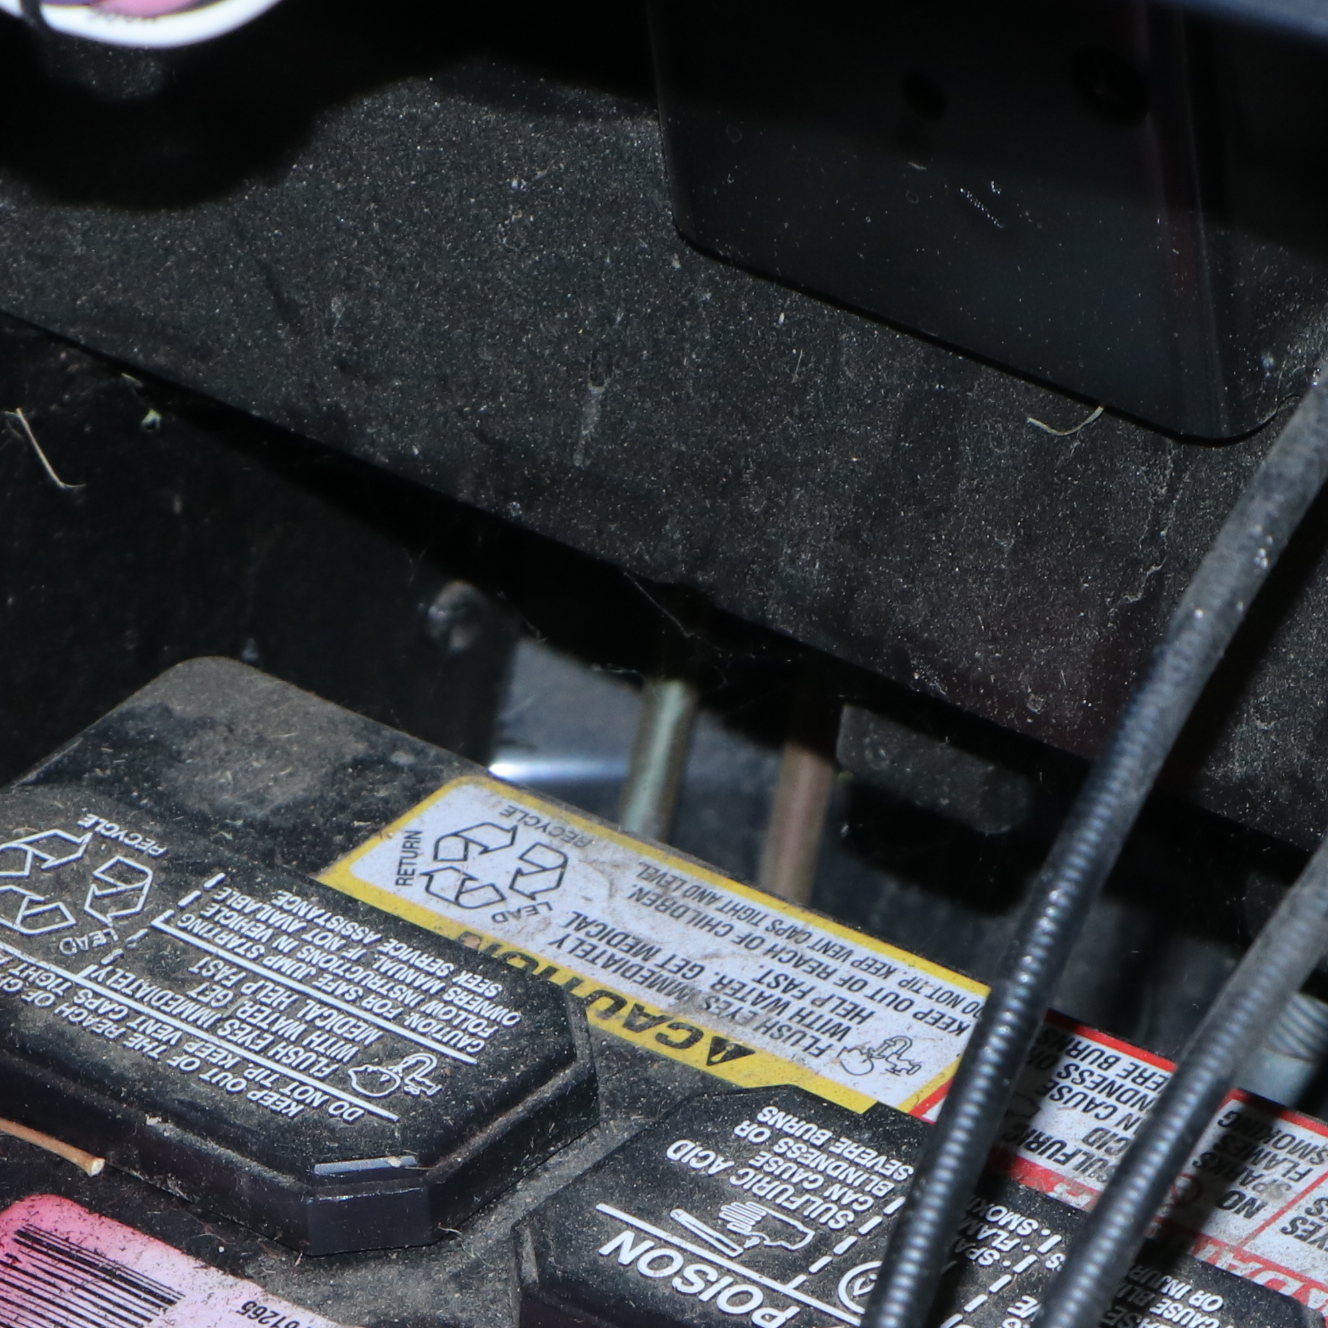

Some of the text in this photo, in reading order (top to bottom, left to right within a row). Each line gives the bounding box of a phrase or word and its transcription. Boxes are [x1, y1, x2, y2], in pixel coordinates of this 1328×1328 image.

[76, 812, 169, 856] RECYCLE
[496, 804, 594, 849] RECYCLE
[211, 887, 524, 1026] OWNERS IF NOT AVAILABLE
[376, 937, 505, 998] SEEK SERVICE
[618, 883, 972, 1037] KEEP OUT OF REACH OF CHILDREN.
[679, 883, 967, 1009] NOT KEEP VENT CAPS TIGHT AND
[8, 960, 76, 993] TIGHT
[173, 913, 486, 1054] CAUTION: FOR SAFE JUMP STARTING
[198, 902, 500, 1038] FOLLOW INSTRUCTIONS IN VEHICLE
[556, 910, 855, 1042] WITH WATER. GET MEDICAL
[21, 987, 59, 1007] OF
[71, 988, 132, 1018] CAPS
[186, 956, 384, 1045] MEDICAL HELP FAST
[744, 963, 876, 1025] HELP FAST.
[52, 1000, 128, 1037] REACH
[87, 963, 340, 1079] FLUSH EYES IMMEDIATELY
[126, 1012, 187, 1043] VENT
[184, 979, 361, 1061] WITH GET
[751, 1016, 835, 1059] FLUSH
[122, 1031, 170, 1056] THE
[165, 1050, 204, 1072] OF
[181, 1036, 243, 1067] KEEP
[198, 1065, 250, 1092] OUT
[277, 1078, 331, 1106] NOT
[245, 1085, 305, 1117] KEEP
[324, 1099, 364, 1121] DO
[728, 1118, 897, 1197] BLINDNESS OR
[750, 1103, 917, 1182] SEVERE BURNS
[657, 1136, 860, 1231] SULFURIC ACID
[745, 1149, 878, 1212] CAN CAUSE
[1210, 1187, 1270, 1220] NO
[1184, 1289, 1227, 1312] OR
